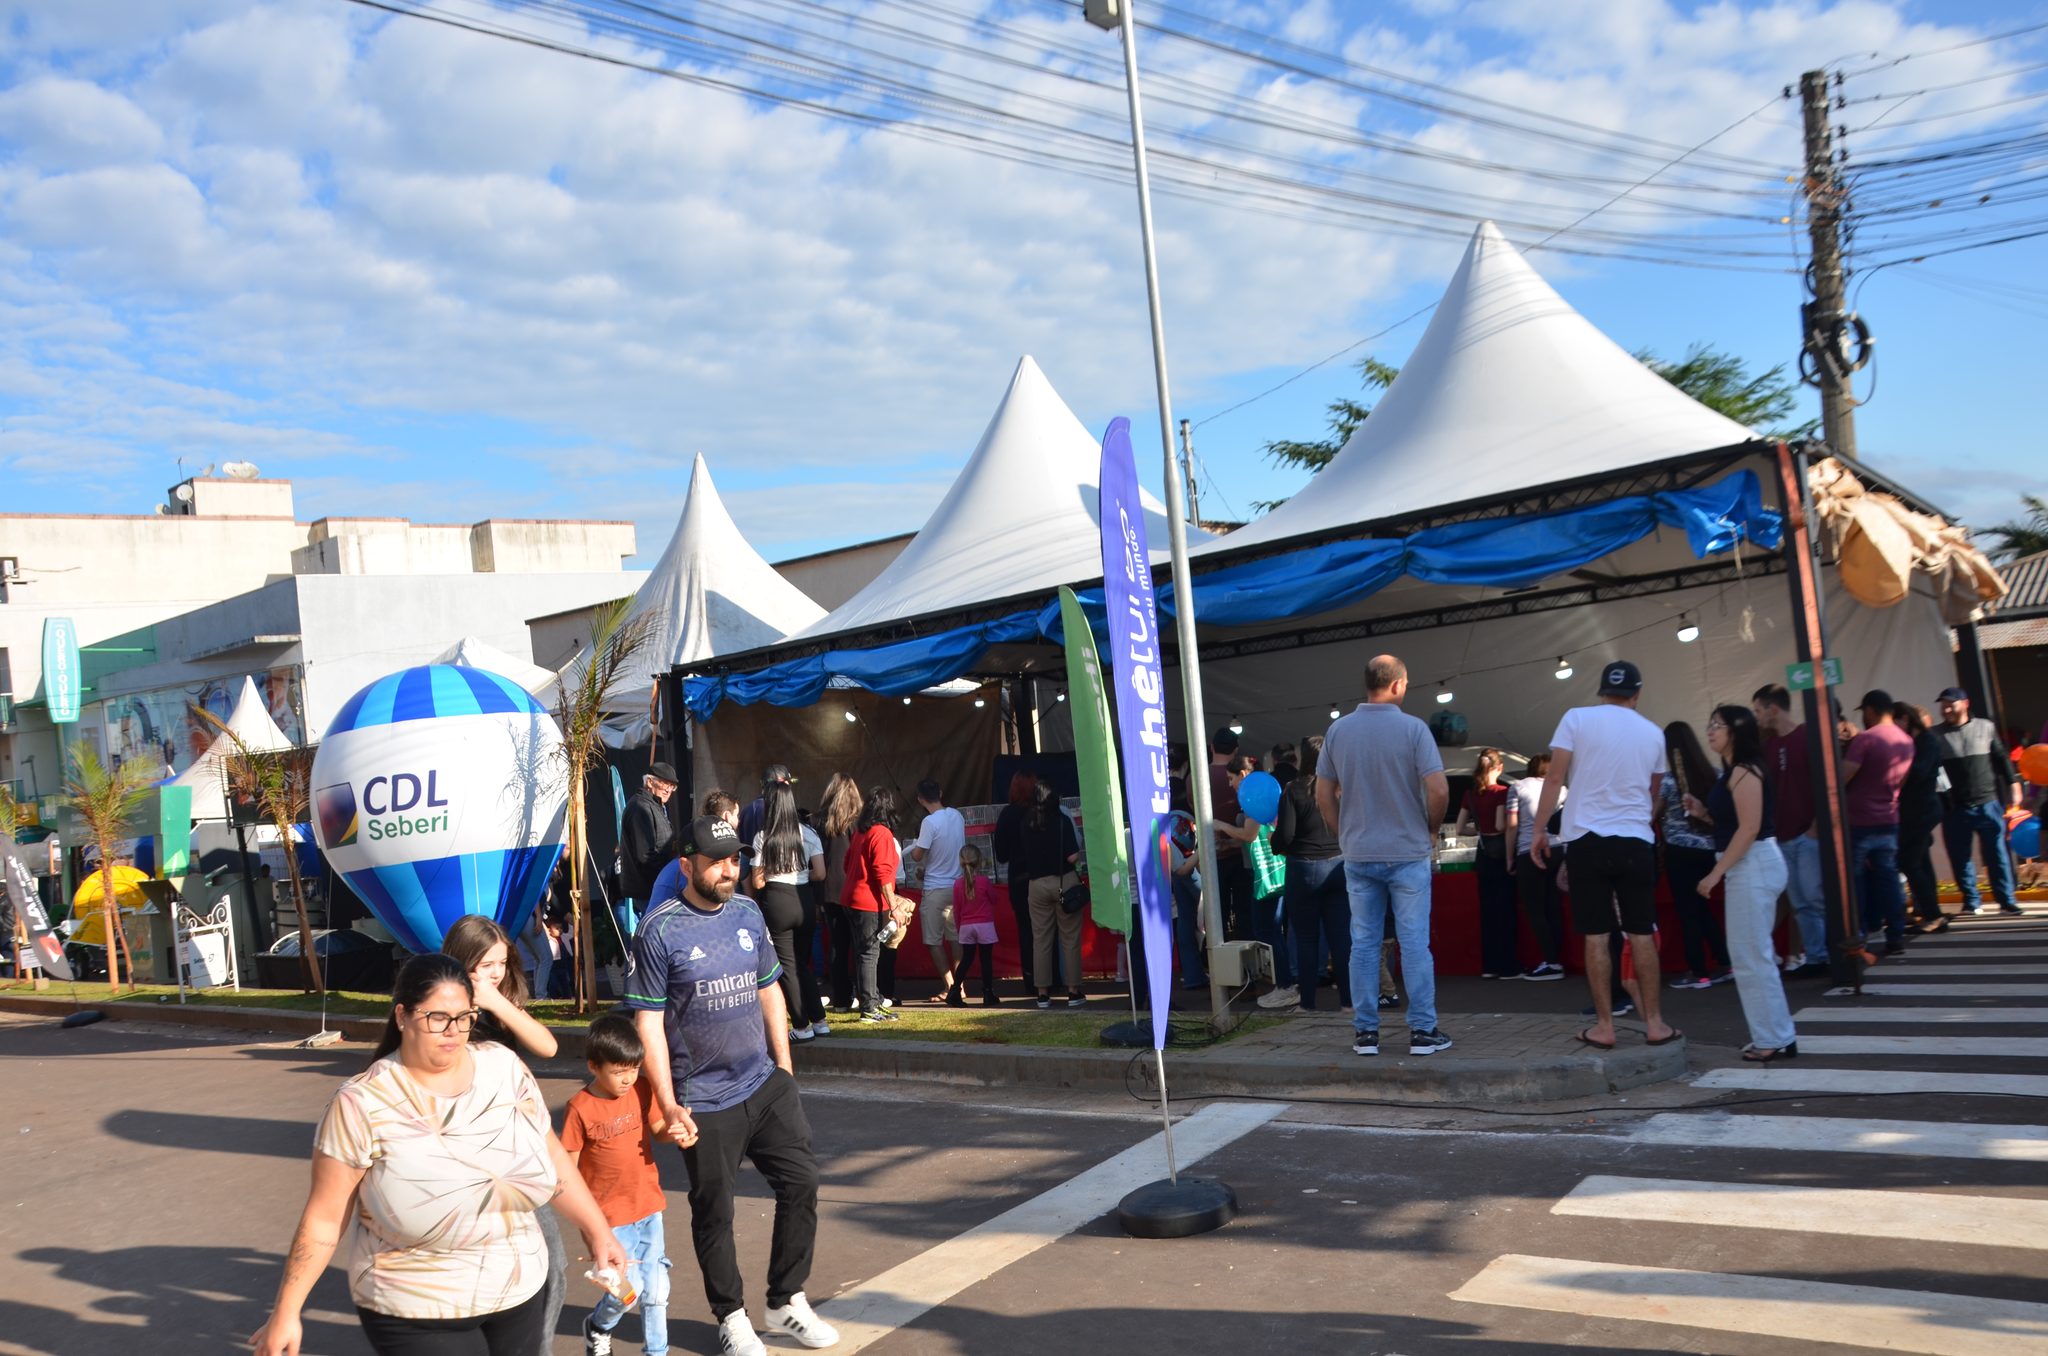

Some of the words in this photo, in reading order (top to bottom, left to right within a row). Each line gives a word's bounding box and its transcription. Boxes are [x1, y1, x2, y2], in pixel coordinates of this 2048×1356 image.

[1130, 525, 1150, 590] mundo.
[363, 769, 448, 816] CDL
[367, 809, 448, 841] Seberi
[708, 996, 726, 1013] FLY
